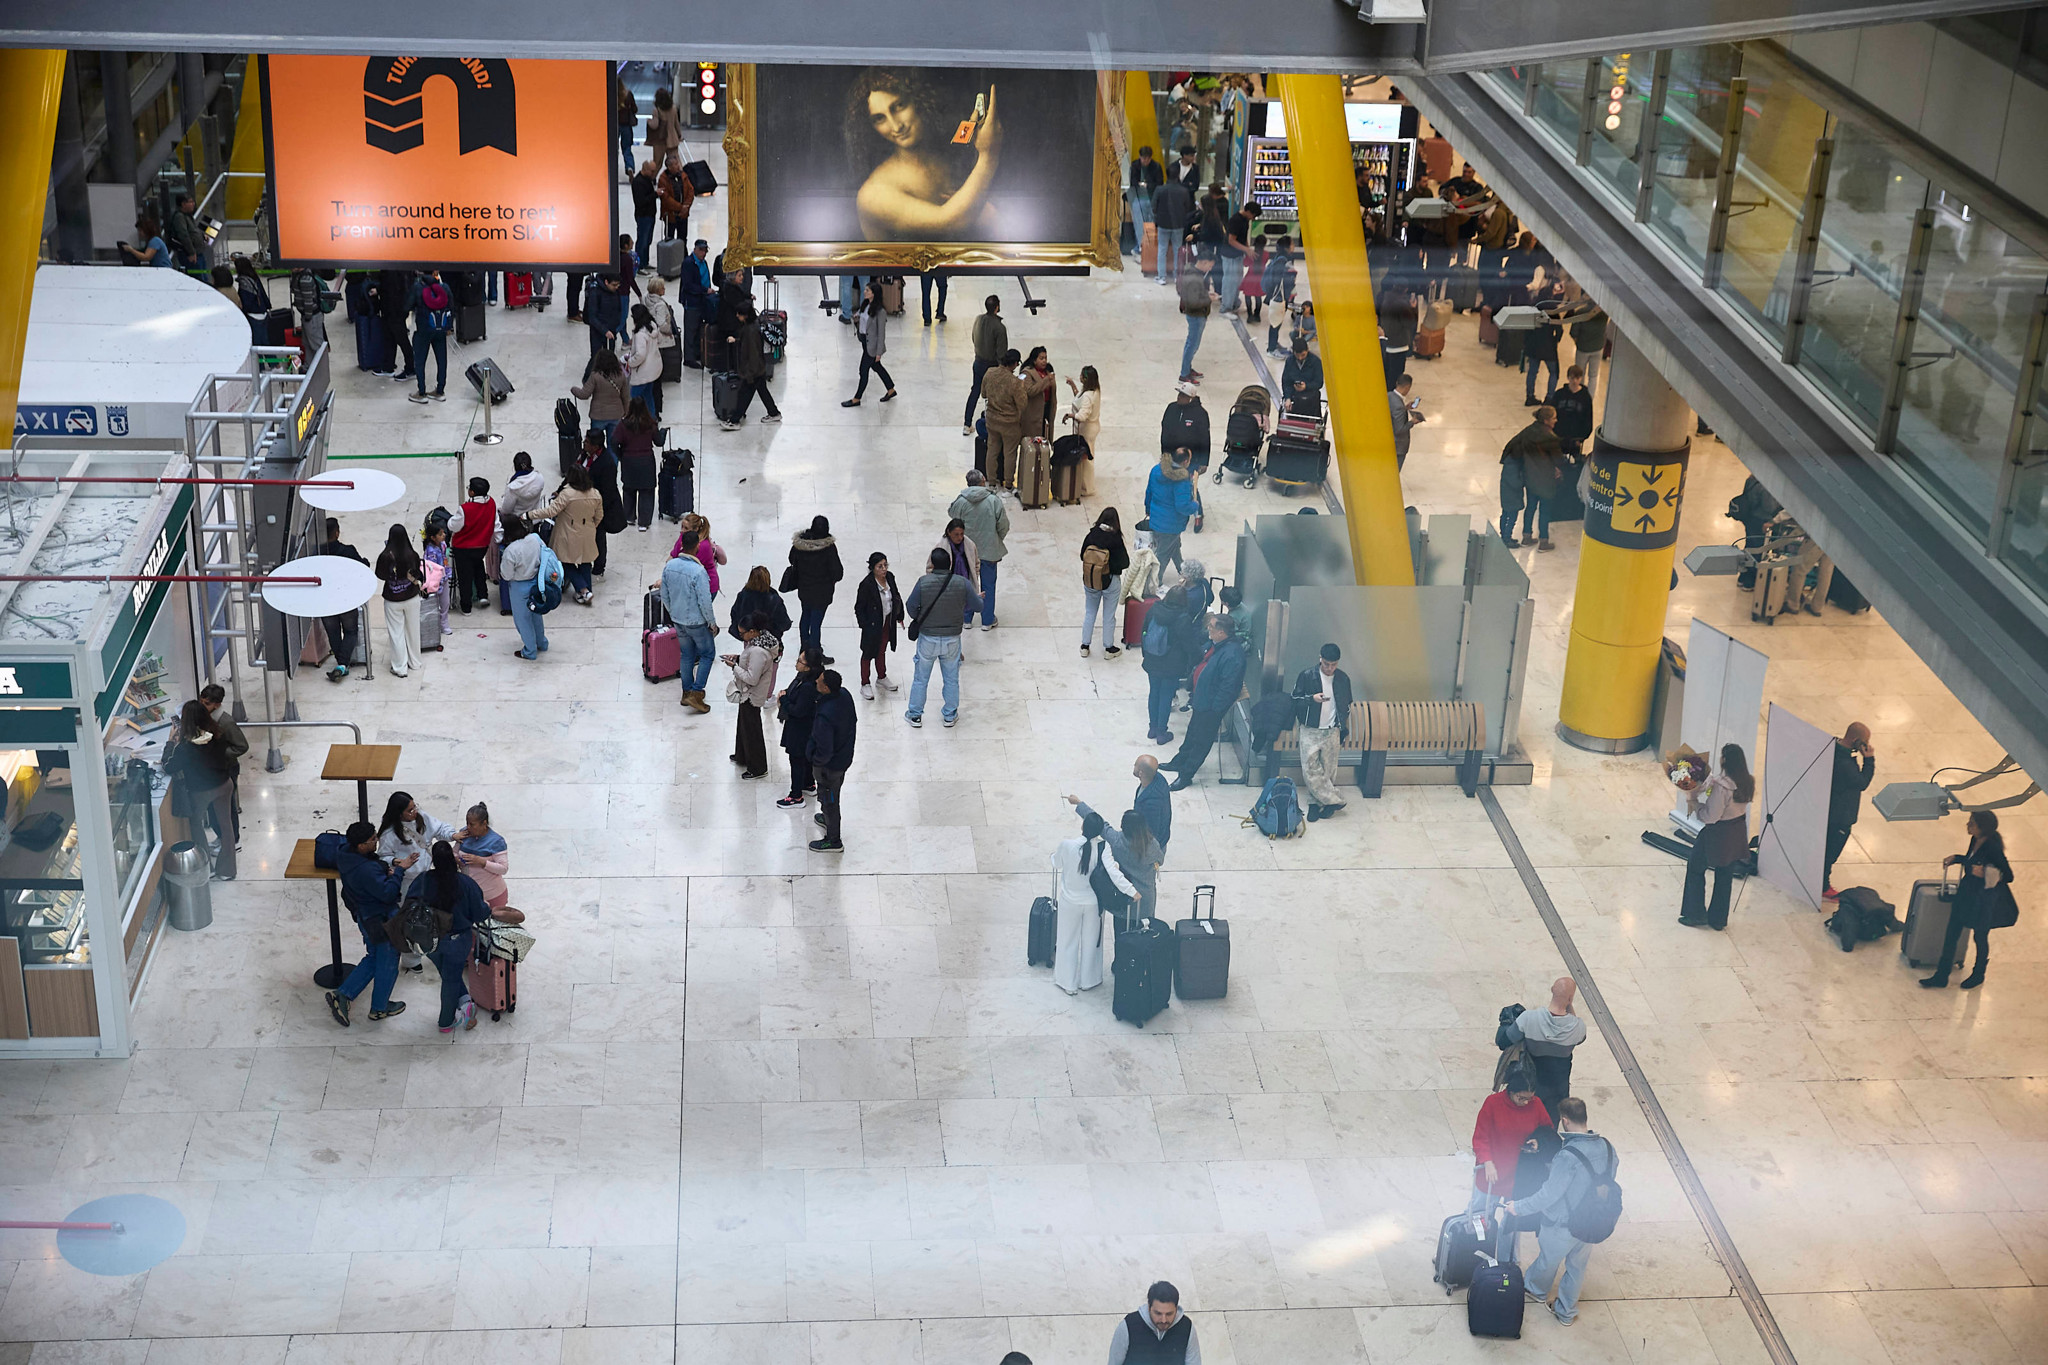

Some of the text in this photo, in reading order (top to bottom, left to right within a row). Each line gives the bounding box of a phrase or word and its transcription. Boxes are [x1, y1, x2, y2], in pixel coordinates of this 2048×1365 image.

[386, 56, 418, 84] TUR
[330, 200, 557, 221] Turn around here to rent
[330, 223, 560, 241] premium cars from SIXT.
[1600, 467, 1611, 480] de
[1594, 501, 1613, 515] point
[133, 527, 169, 616] RODILLA
